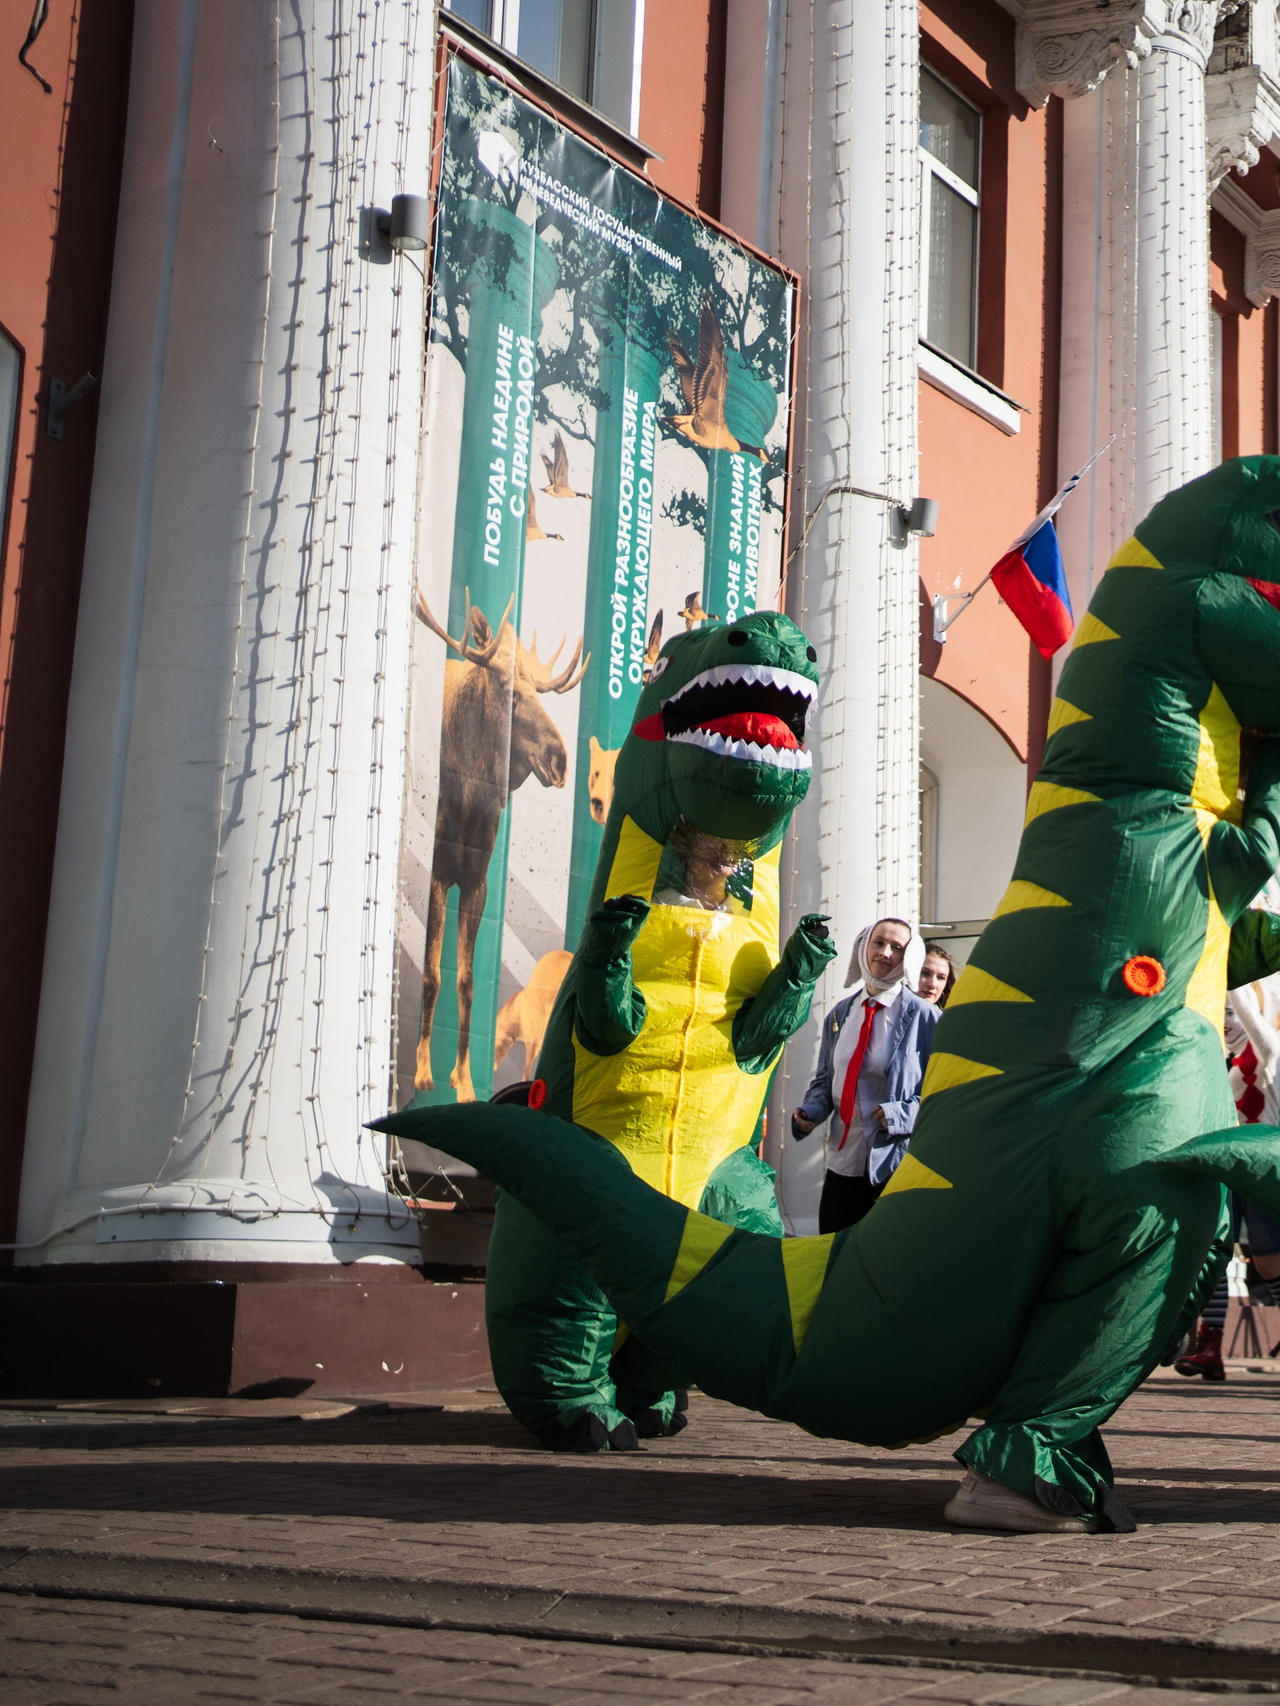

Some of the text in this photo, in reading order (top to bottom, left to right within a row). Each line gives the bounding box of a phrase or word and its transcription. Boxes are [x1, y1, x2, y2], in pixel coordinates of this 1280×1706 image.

[519, 174, 634, 256] КРАЕВЕДЧЕСКИЙ МУЗЕЙ
[520, 157, 683, 272] КУЗБАССКИЙ ГОСУДАРСТВЕННЫЙ
[483, 322, 514, 567] ПОБУДЬ НАЕДИНЕ
[509, 335, 535, 518] С ПРИРОДОЙ
[729, 453, 746, 555] ЗНАНИЙ
[608, 386, 639, 699] ОТКРОЙ РАЗНООБРАЗИЕ
[628, 401, 656, 684] ОКРУЖАЮЩЕГО МИРА
[744, 461, 763, 602] ЖИВОТНЫХ
